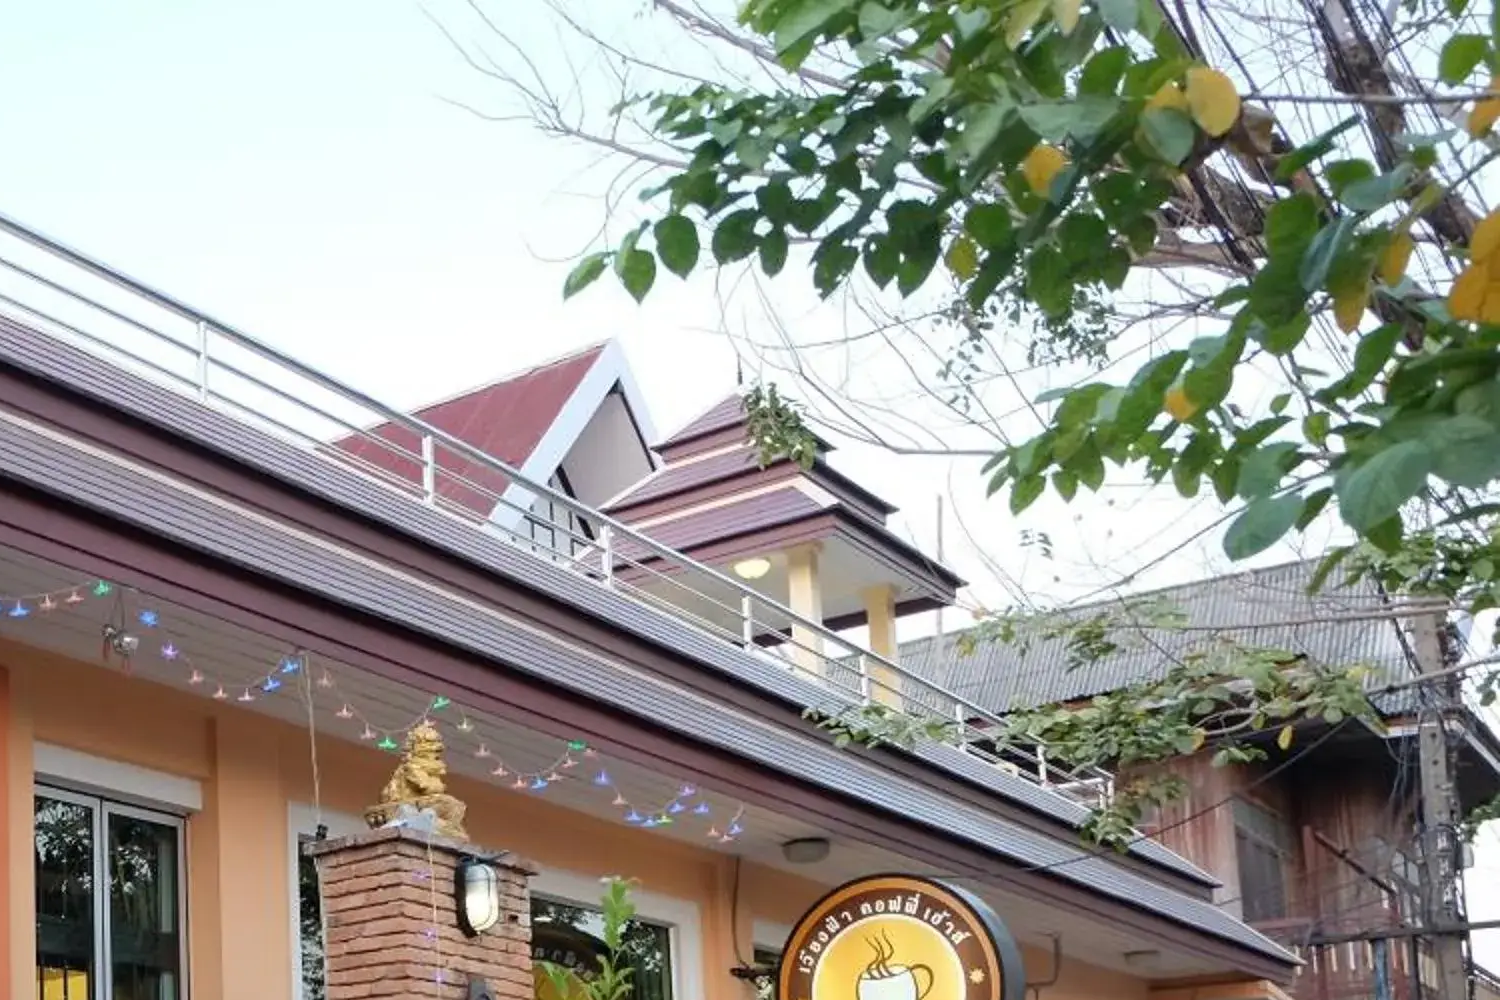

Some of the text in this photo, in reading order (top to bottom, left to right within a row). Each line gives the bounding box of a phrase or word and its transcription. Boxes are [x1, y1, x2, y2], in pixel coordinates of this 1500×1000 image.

[860, 893, 921, 915] คอฟฟี่
[923, 908, 972, 945] เฮ้าส์
